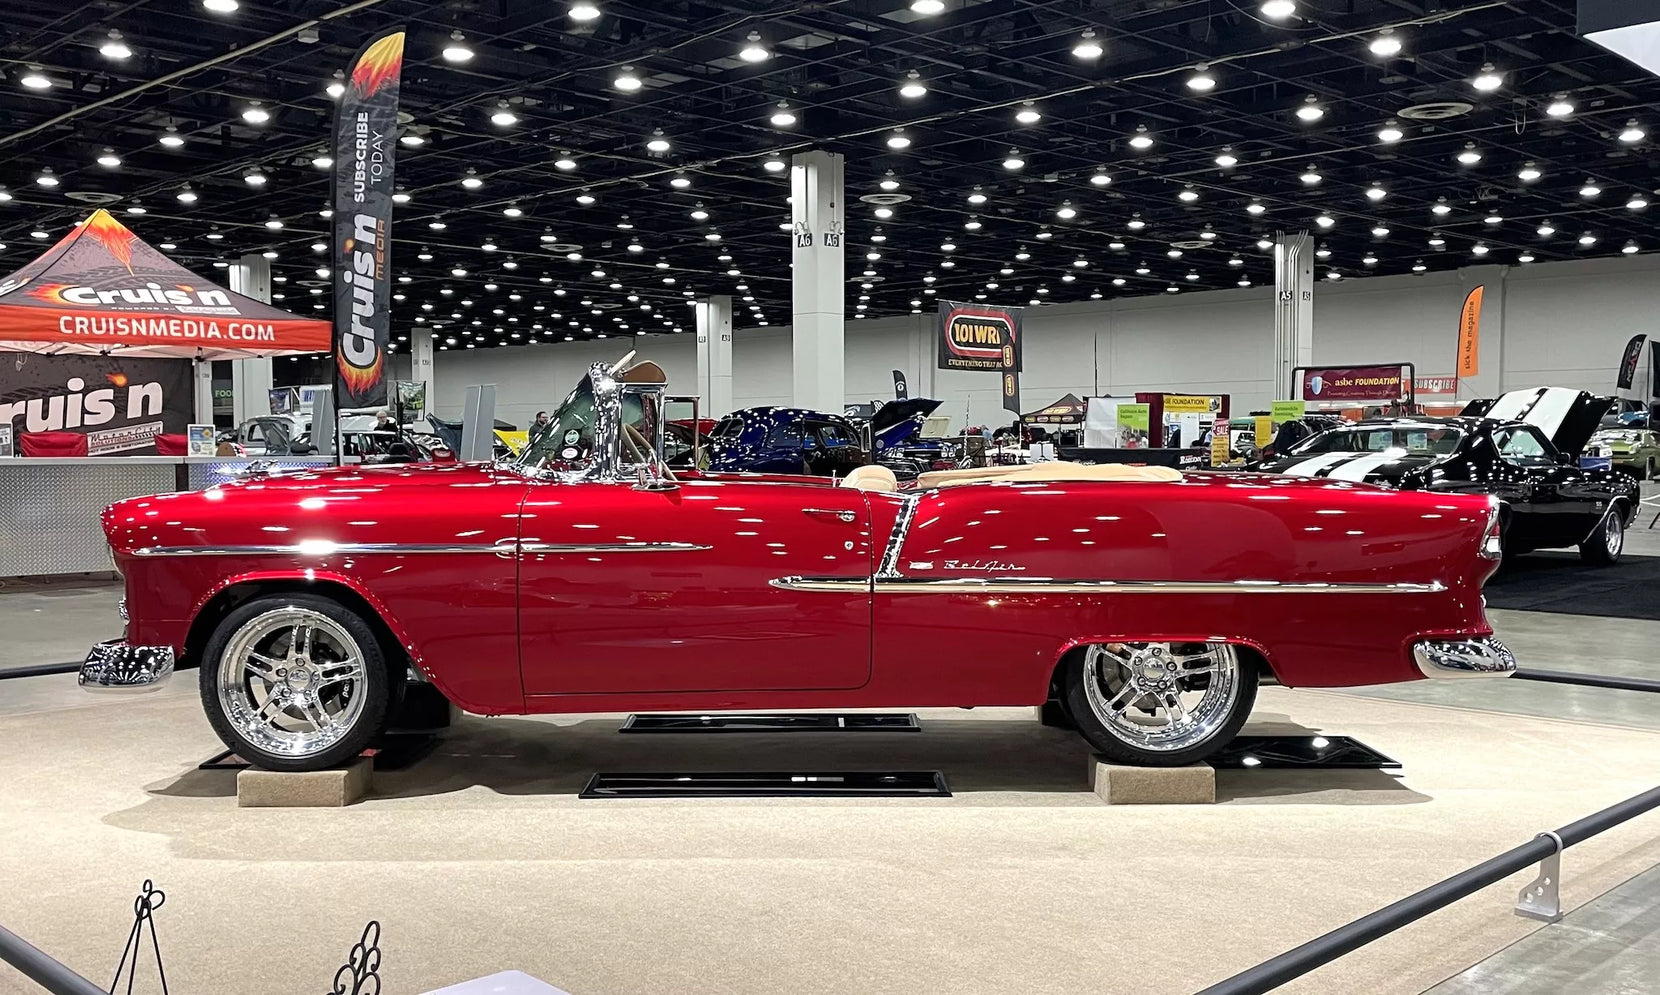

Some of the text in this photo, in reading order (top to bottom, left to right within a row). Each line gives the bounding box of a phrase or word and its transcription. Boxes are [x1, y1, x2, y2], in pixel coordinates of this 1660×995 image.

[354, 112, 368, 203] SUBSCRIBE
[371, 130, 383, 185] TODAY
[799, 234, 811, 247] A6
[826, 234, 838, 247] A6
[376, 219, 385, 281] MEDIA
[59, 316, 275, 341] CRUISNMEDIA.COM
[1355, 377, 1400, 386] FOUNDATION
[1414, 379, 1455, 390] SUBSCRIBE
[1216, 426, 1229, 435] SALE
